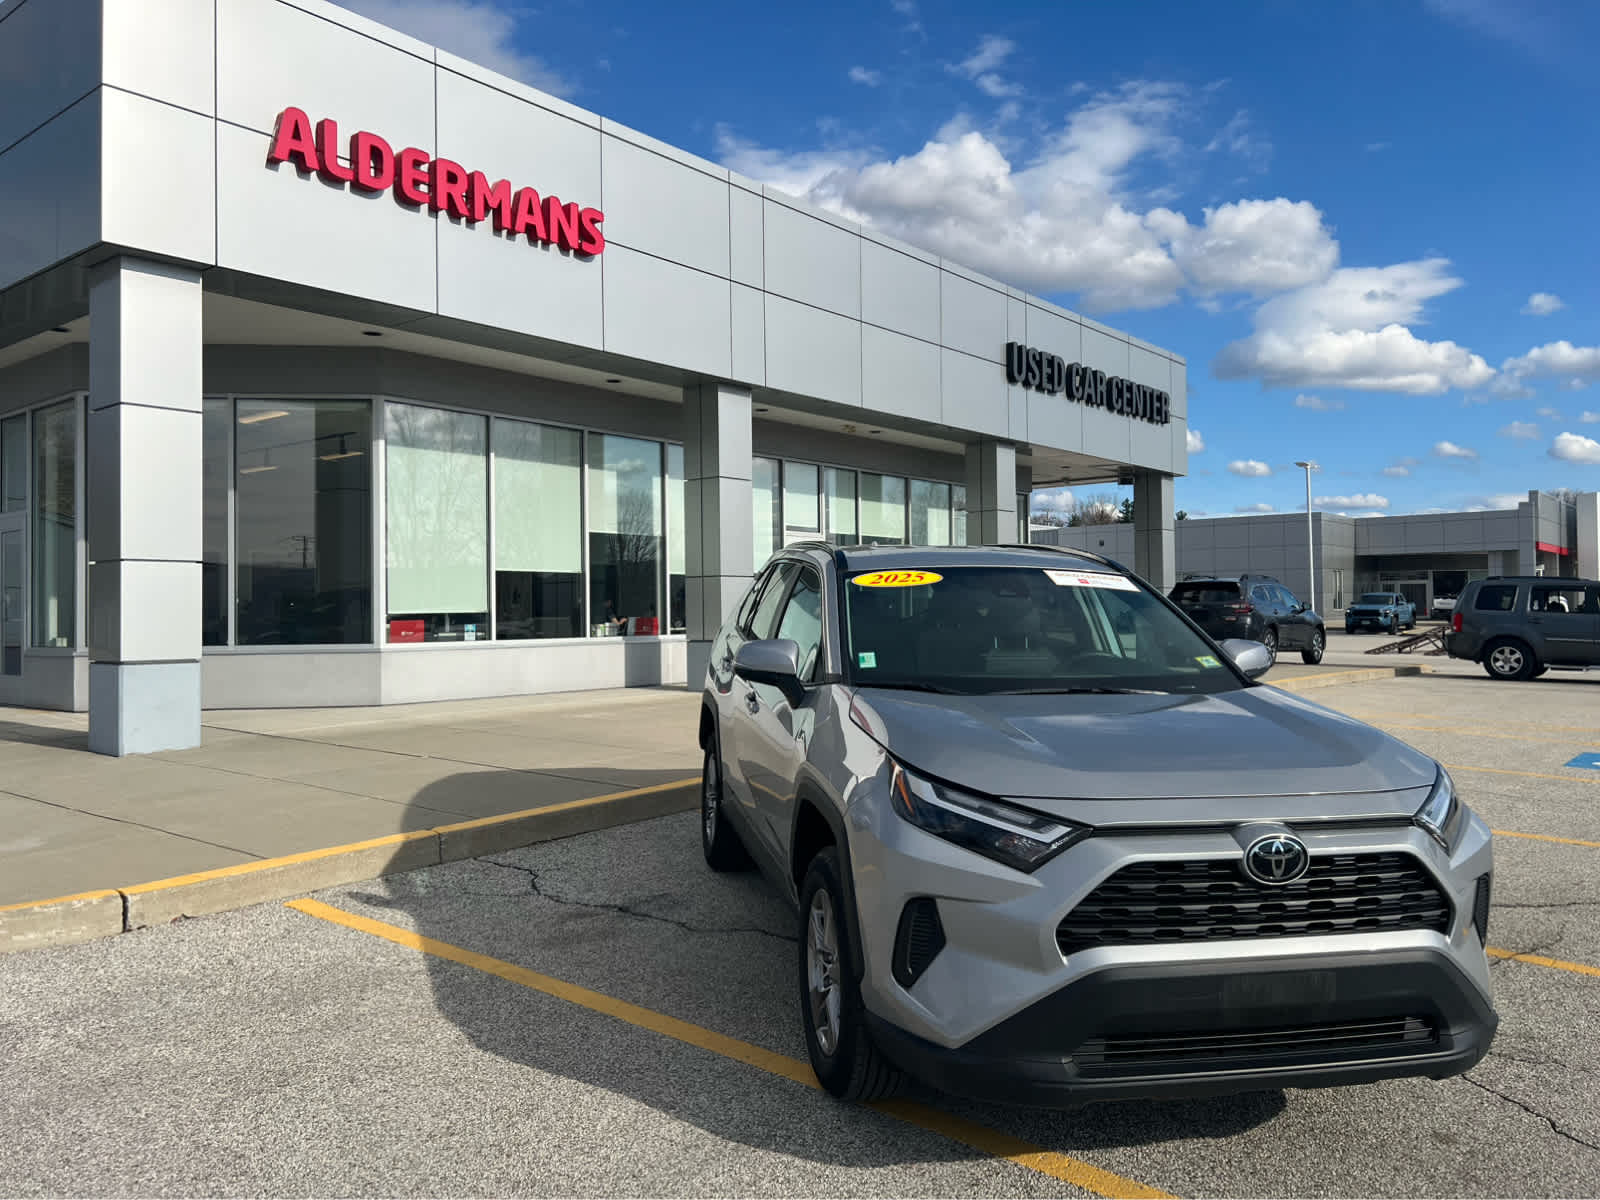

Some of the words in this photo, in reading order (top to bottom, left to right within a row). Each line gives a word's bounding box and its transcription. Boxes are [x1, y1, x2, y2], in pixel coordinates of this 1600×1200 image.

[267, 106, 604, 257] ALDERMANS
[1006, 341, 1065, 394] USED
[1067, 362, 1107, 407] CAR
[1107, 376, 1170, 425] CENTER
[869, 573, 926, 584] 2025
